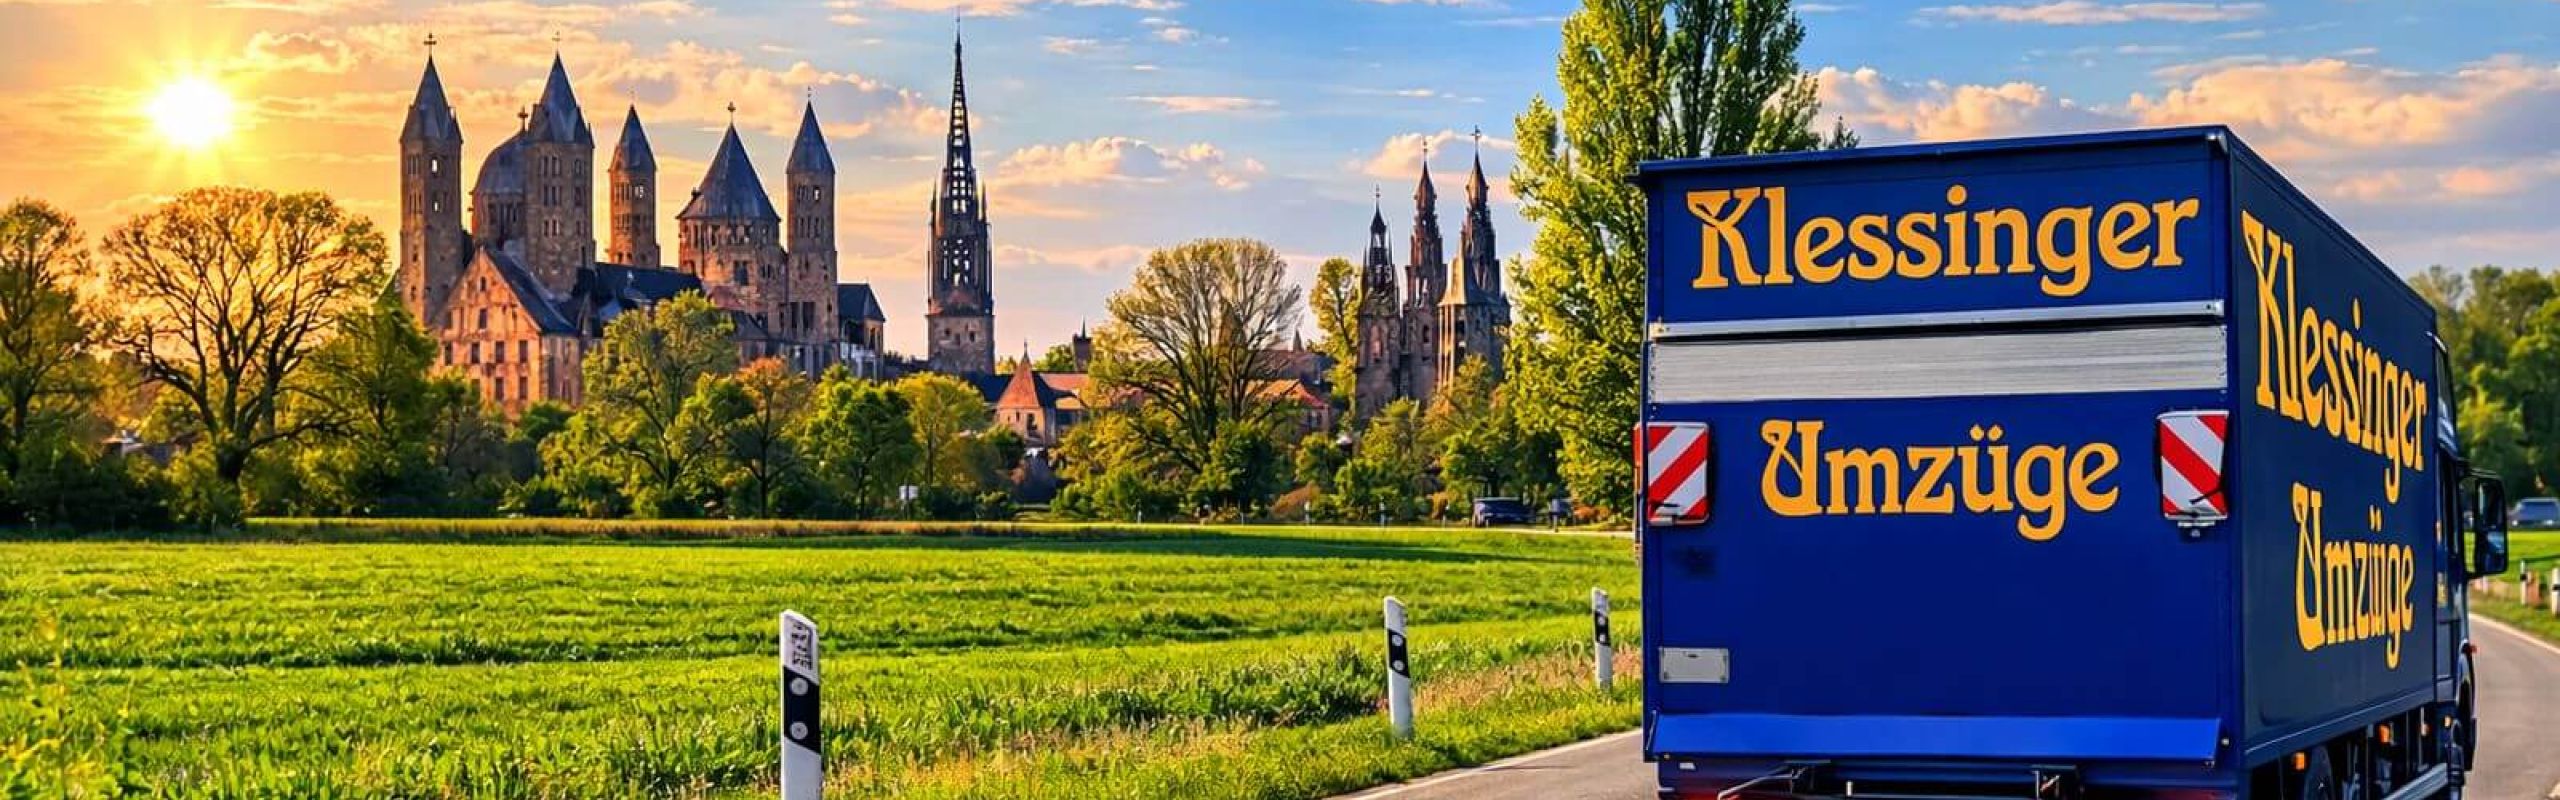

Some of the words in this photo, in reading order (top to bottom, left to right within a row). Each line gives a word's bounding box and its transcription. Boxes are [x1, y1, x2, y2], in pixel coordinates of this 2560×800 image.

[1687, 185, 2199, 297] Klessinger
[2242, 211, 2427, 503] Klessinger
[1761, 419, 2119, 540] Umzüge
[2292, 482, 2414, 668] Umzüge
